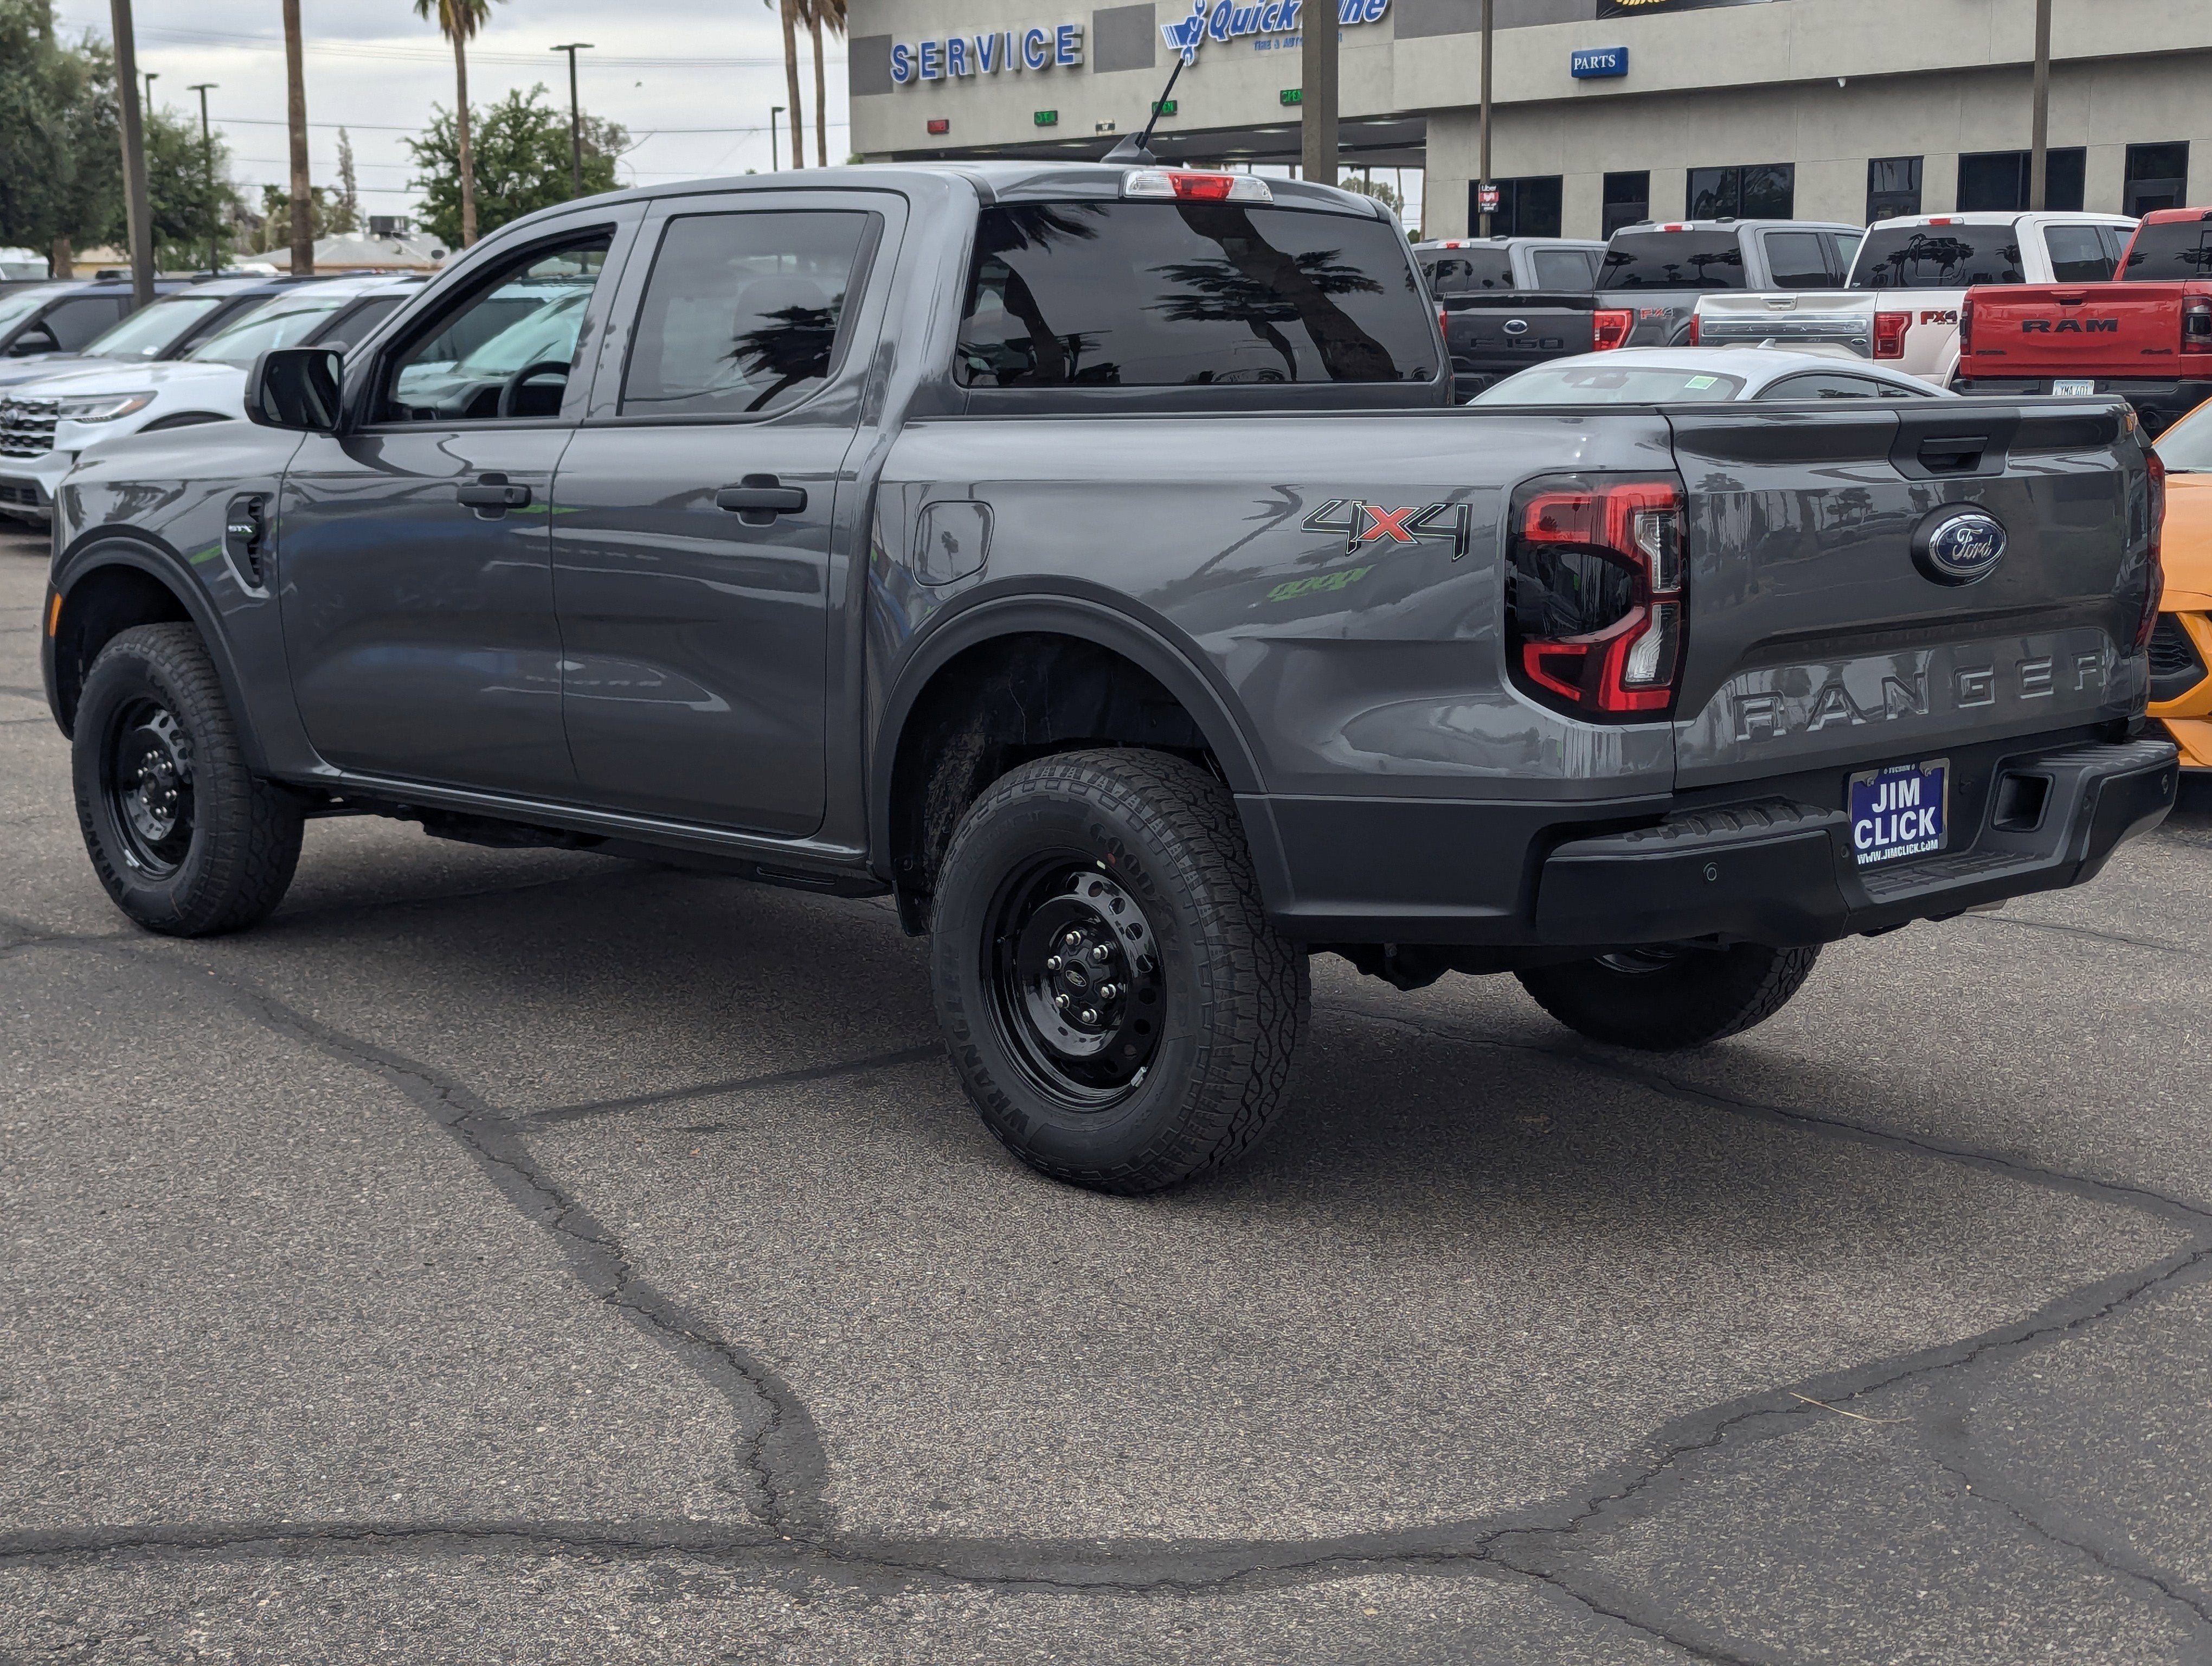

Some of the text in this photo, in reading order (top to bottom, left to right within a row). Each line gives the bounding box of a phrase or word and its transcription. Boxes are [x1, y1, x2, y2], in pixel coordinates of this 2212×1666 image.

[890, 24, 1083, 84] SERVICE
[1573, 54, 1616, 71] PARTS
[1920, 310, 1958, 325] FX4
[2022, 318, 2118, 333] RAM
[1470, 338, 1564, 350] F-150
[1952, 528, 1994, 561] Ford
[1732, 649, 2107, 742] RANGER
[1872, 777, 1920, 813] JIM
[1854, 806, 1936, 849] CLICK
[1857, 839, 1938, 865] WWW.JIMCLICK.COM
